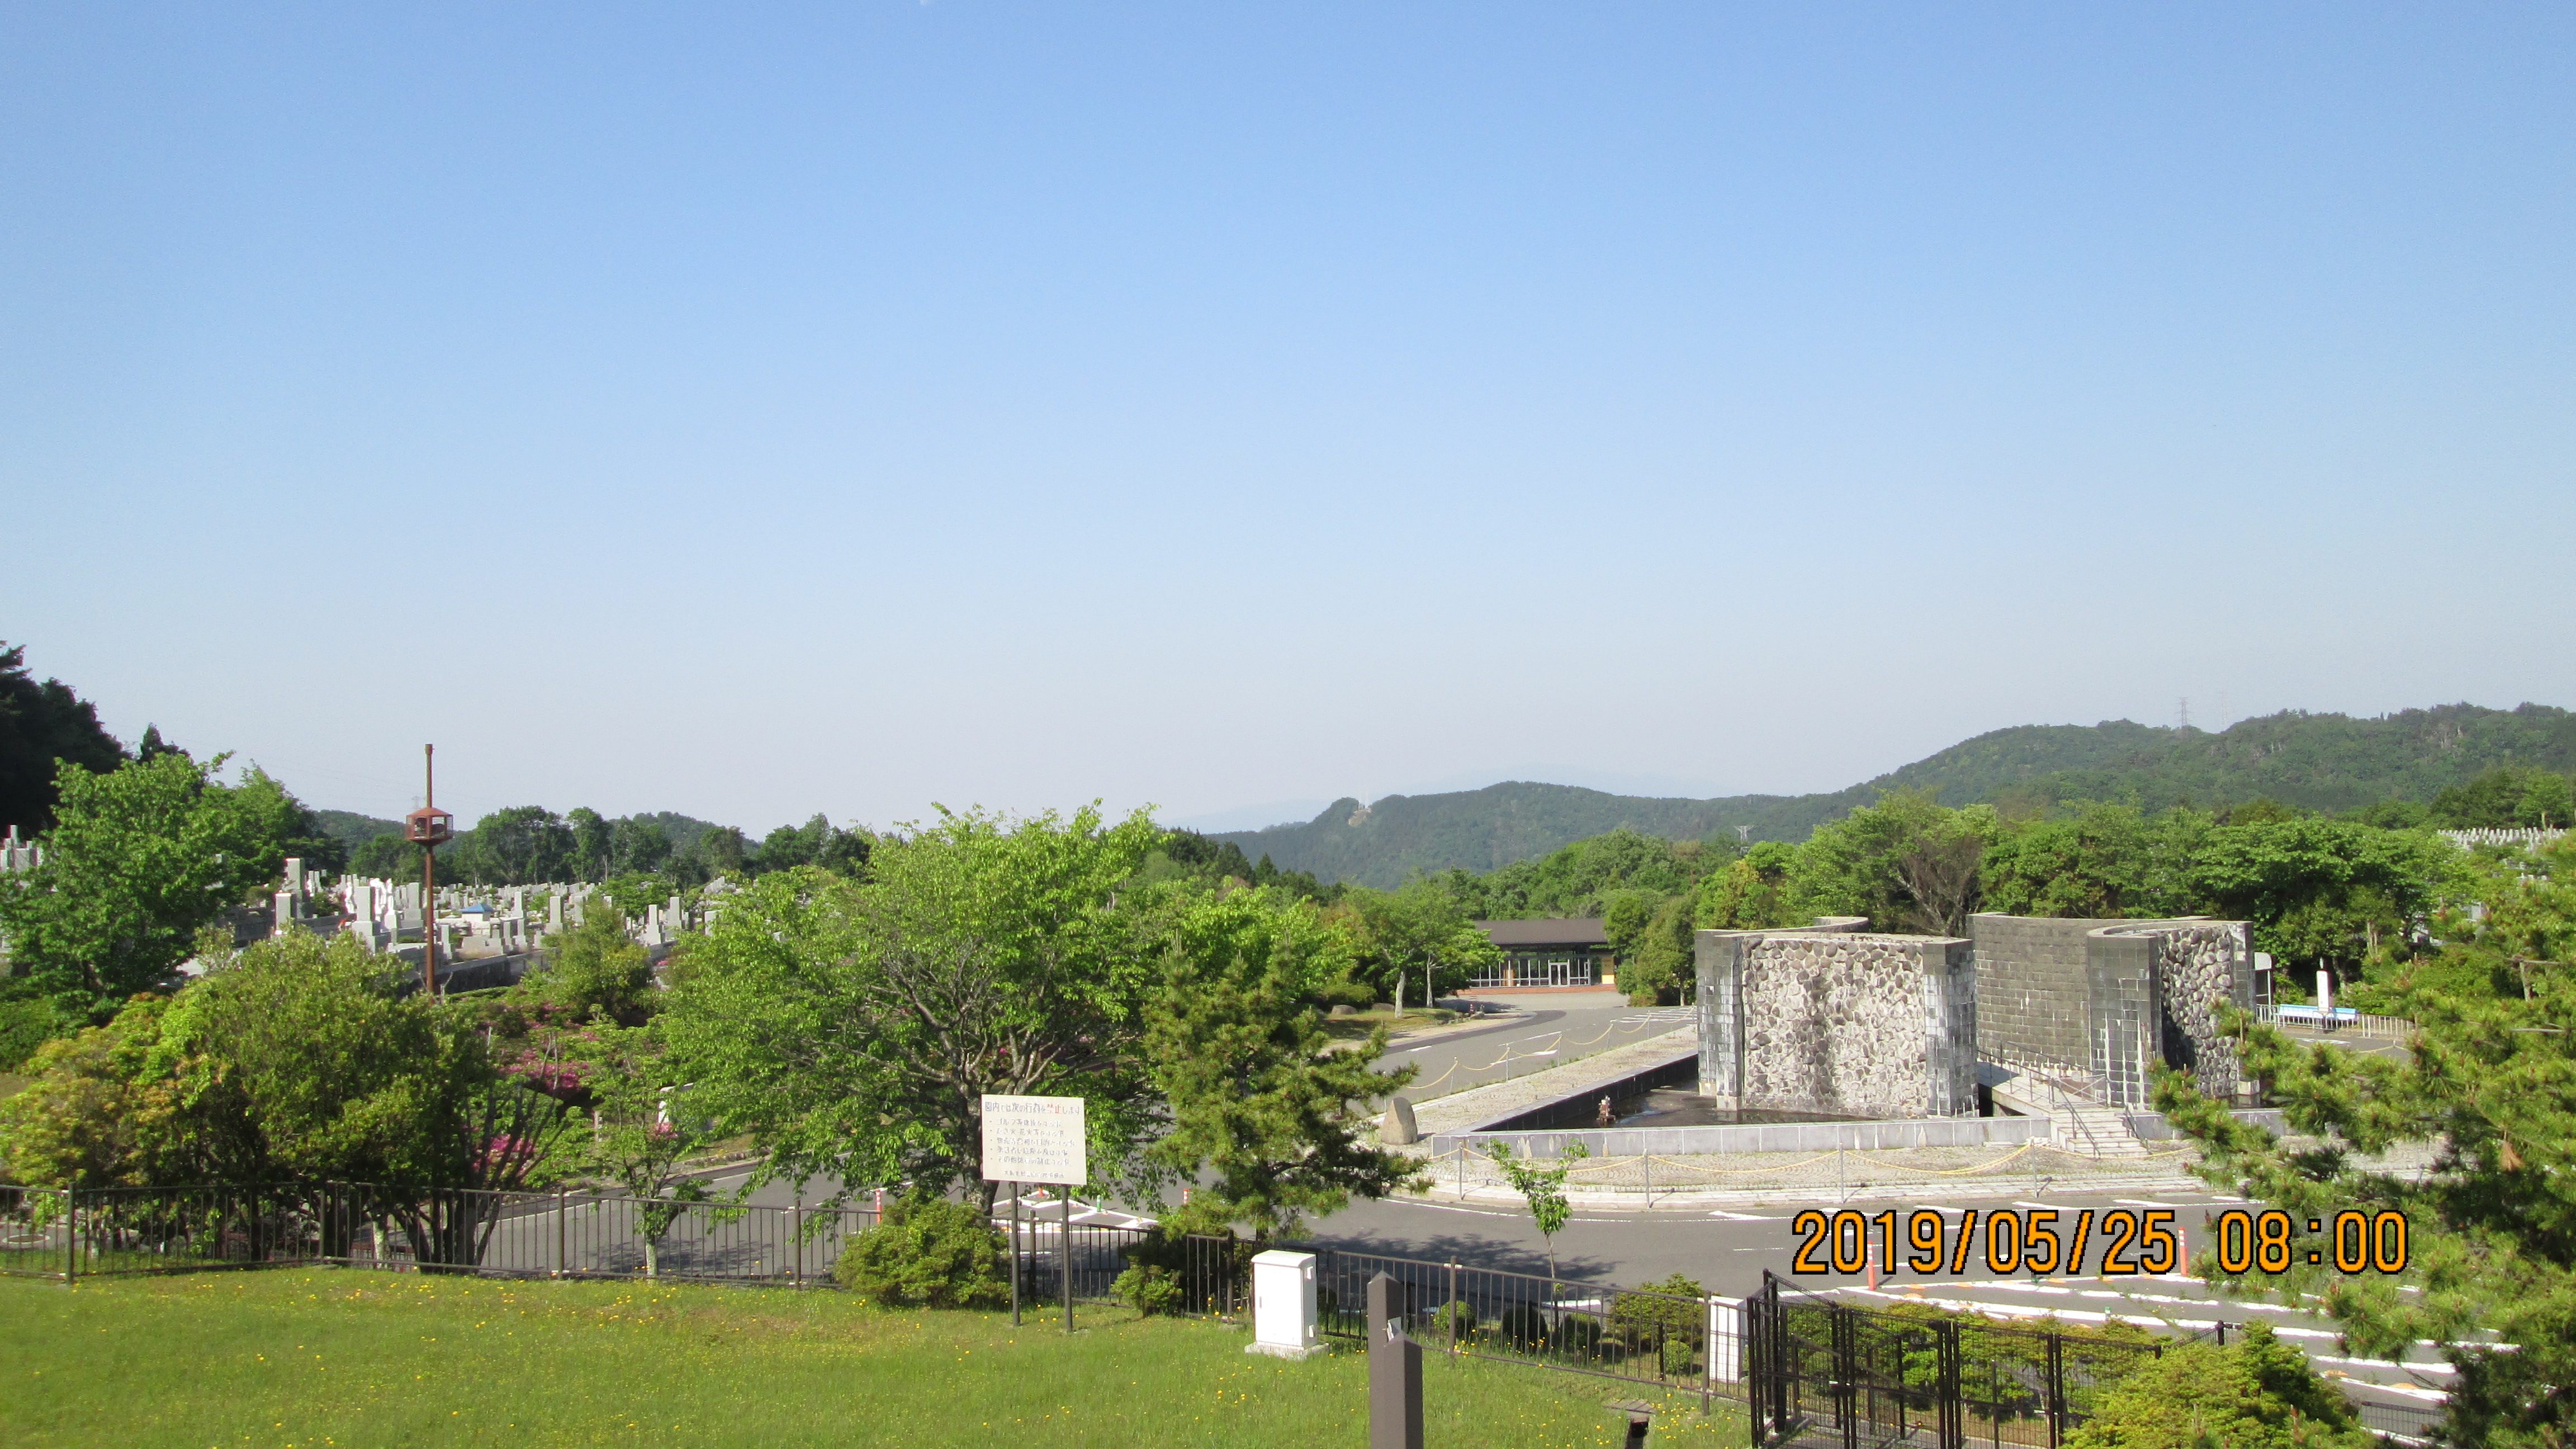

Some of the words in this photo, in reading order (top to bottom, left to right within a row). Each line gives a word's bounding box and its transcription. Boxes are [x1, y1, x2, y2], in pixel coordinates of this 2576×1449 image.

[985, 1102, 1079, 1115] 園内では次の行為を禁止します
